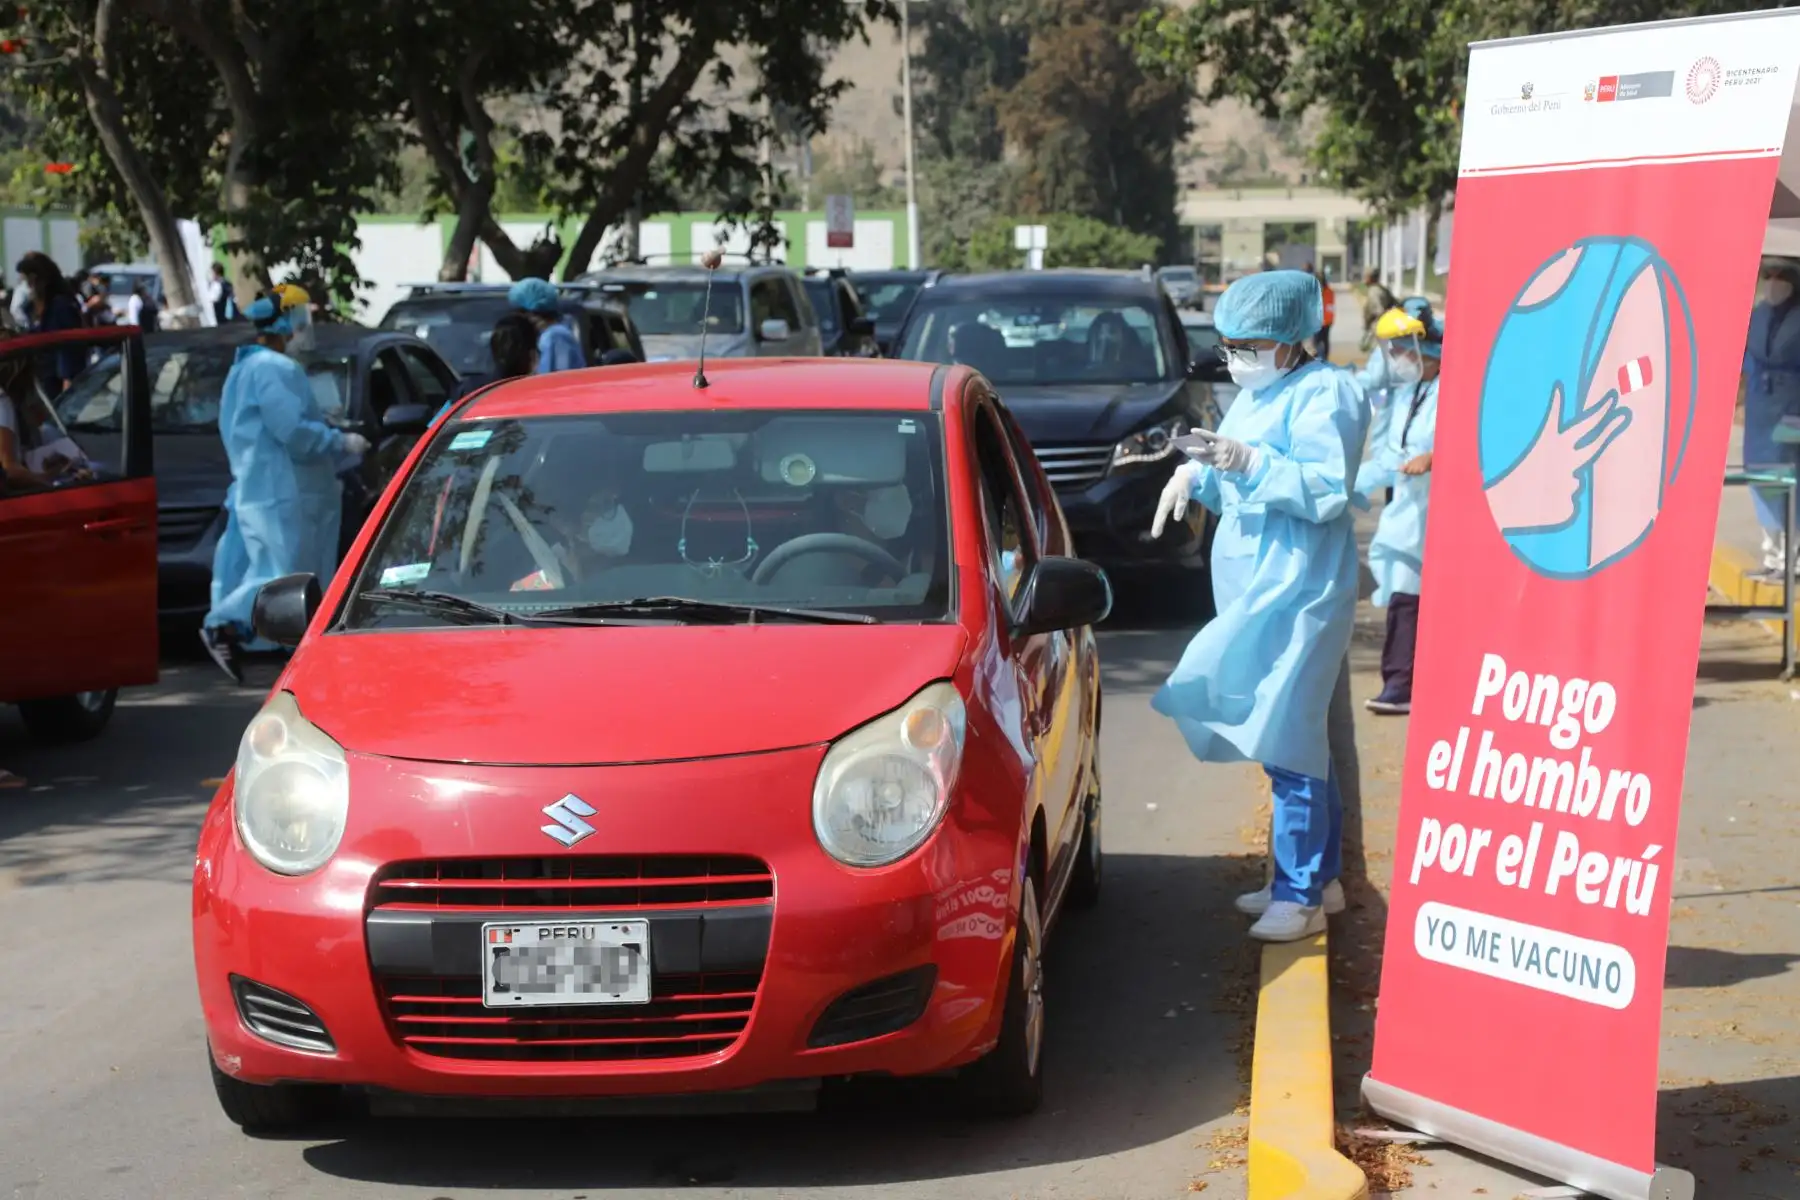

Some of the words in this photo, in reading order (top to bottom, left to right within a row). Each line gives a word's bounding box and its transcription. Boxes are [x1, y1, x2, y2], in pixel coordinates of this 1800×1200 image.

[1528, 99, 1541, 112] del
[1726, 66, 1779, 77] BICENTENARIO
[1472, 653, 1617, 750] Pongo
[1426, 726, 1471, 792] el
[1469, 730, 1651, 827] hombro
[1409, 817, 1493, 886] por
[1495, 821, 1544, 889] el
[1544, 830, 1663, 916] Perú
[538, 926, 595, 941] PERU
[1426, 916, 1457, 952] YO
[1466, 926, 1502, 964] ME
[1510, 936, 1622, 994] VACUNO
